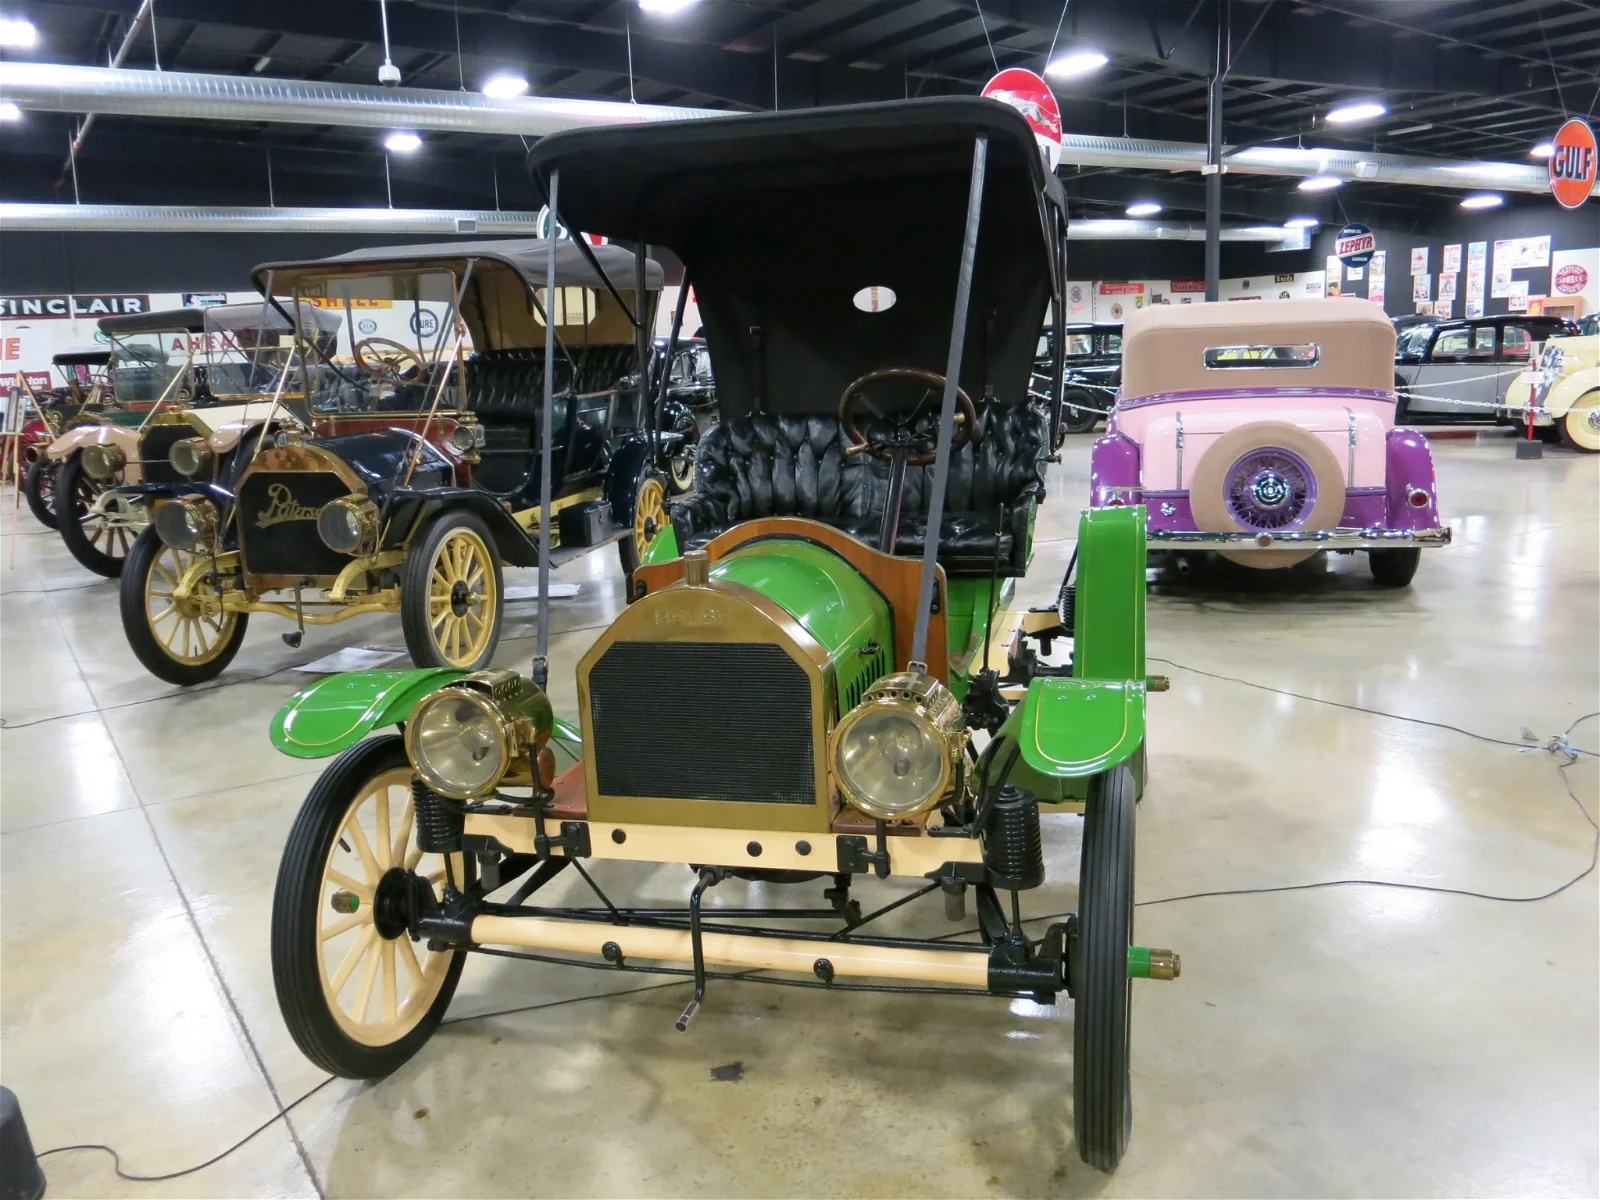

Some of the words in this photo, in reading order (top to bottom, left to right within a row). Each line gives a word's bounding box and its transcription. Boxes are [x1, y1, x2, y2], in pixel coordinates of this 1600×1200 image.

[1553, 146, 1592, 179] GULF
[1339, 236, 1373, 254] ZEPHYR
[417, 319, 435, 329] URE
